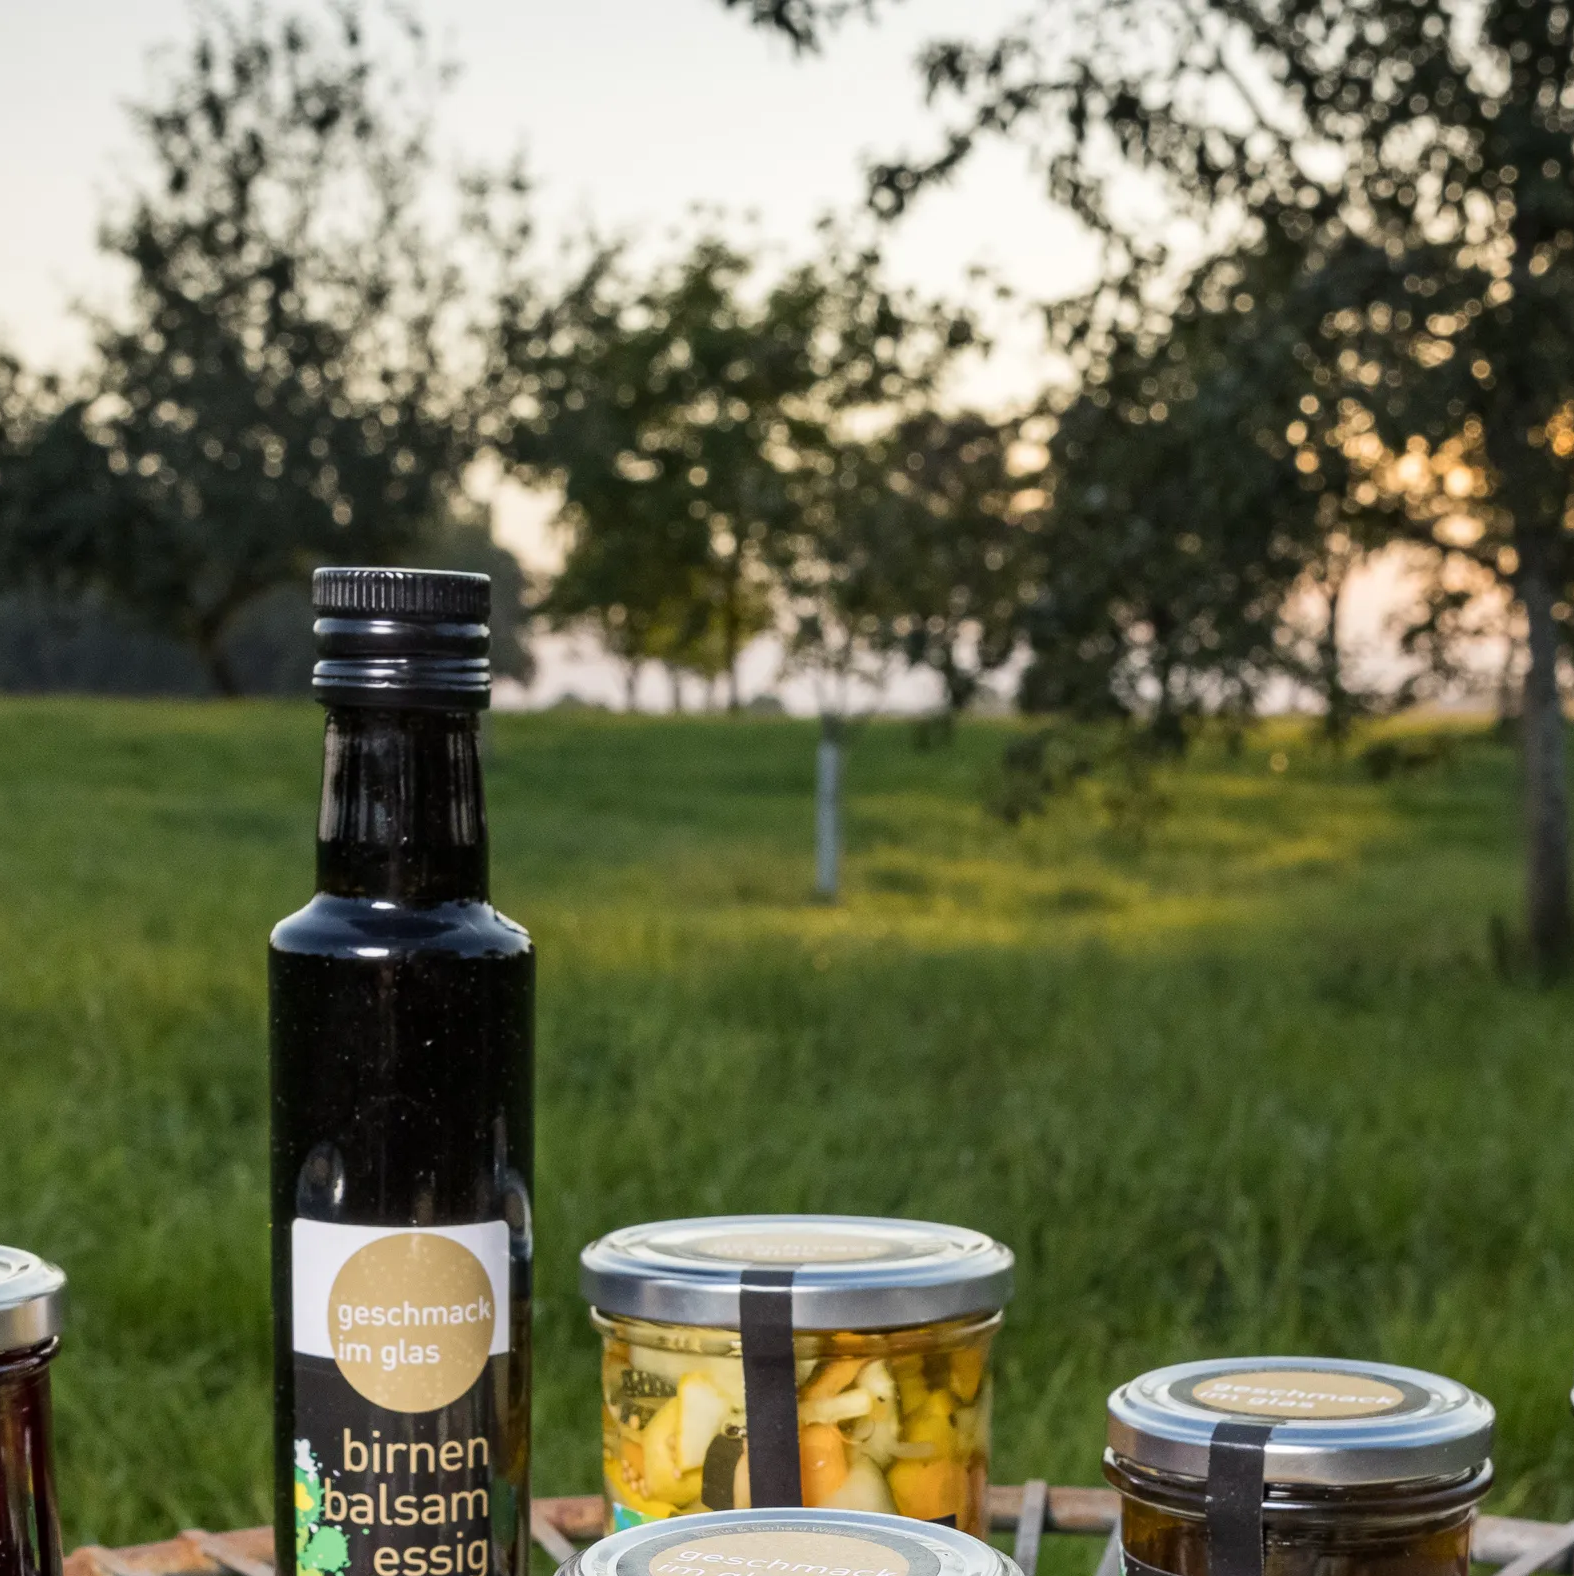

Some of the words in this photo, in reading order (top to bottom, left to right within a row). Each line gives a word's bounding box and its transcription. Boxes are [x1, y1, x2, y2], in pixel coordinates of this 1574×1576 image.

[337, 1296, 491, 1330] geschmack
[338, 1336, 371, 1363] im
[380, 1339, 440, 1372] glas
[1213, 1382, 1394, 1405] geschmack
[1248, 1396, 1315, 1409] glas
[343, 1428, 489, 1474] birnen
[324, 1477, 489, 1526] balsam
